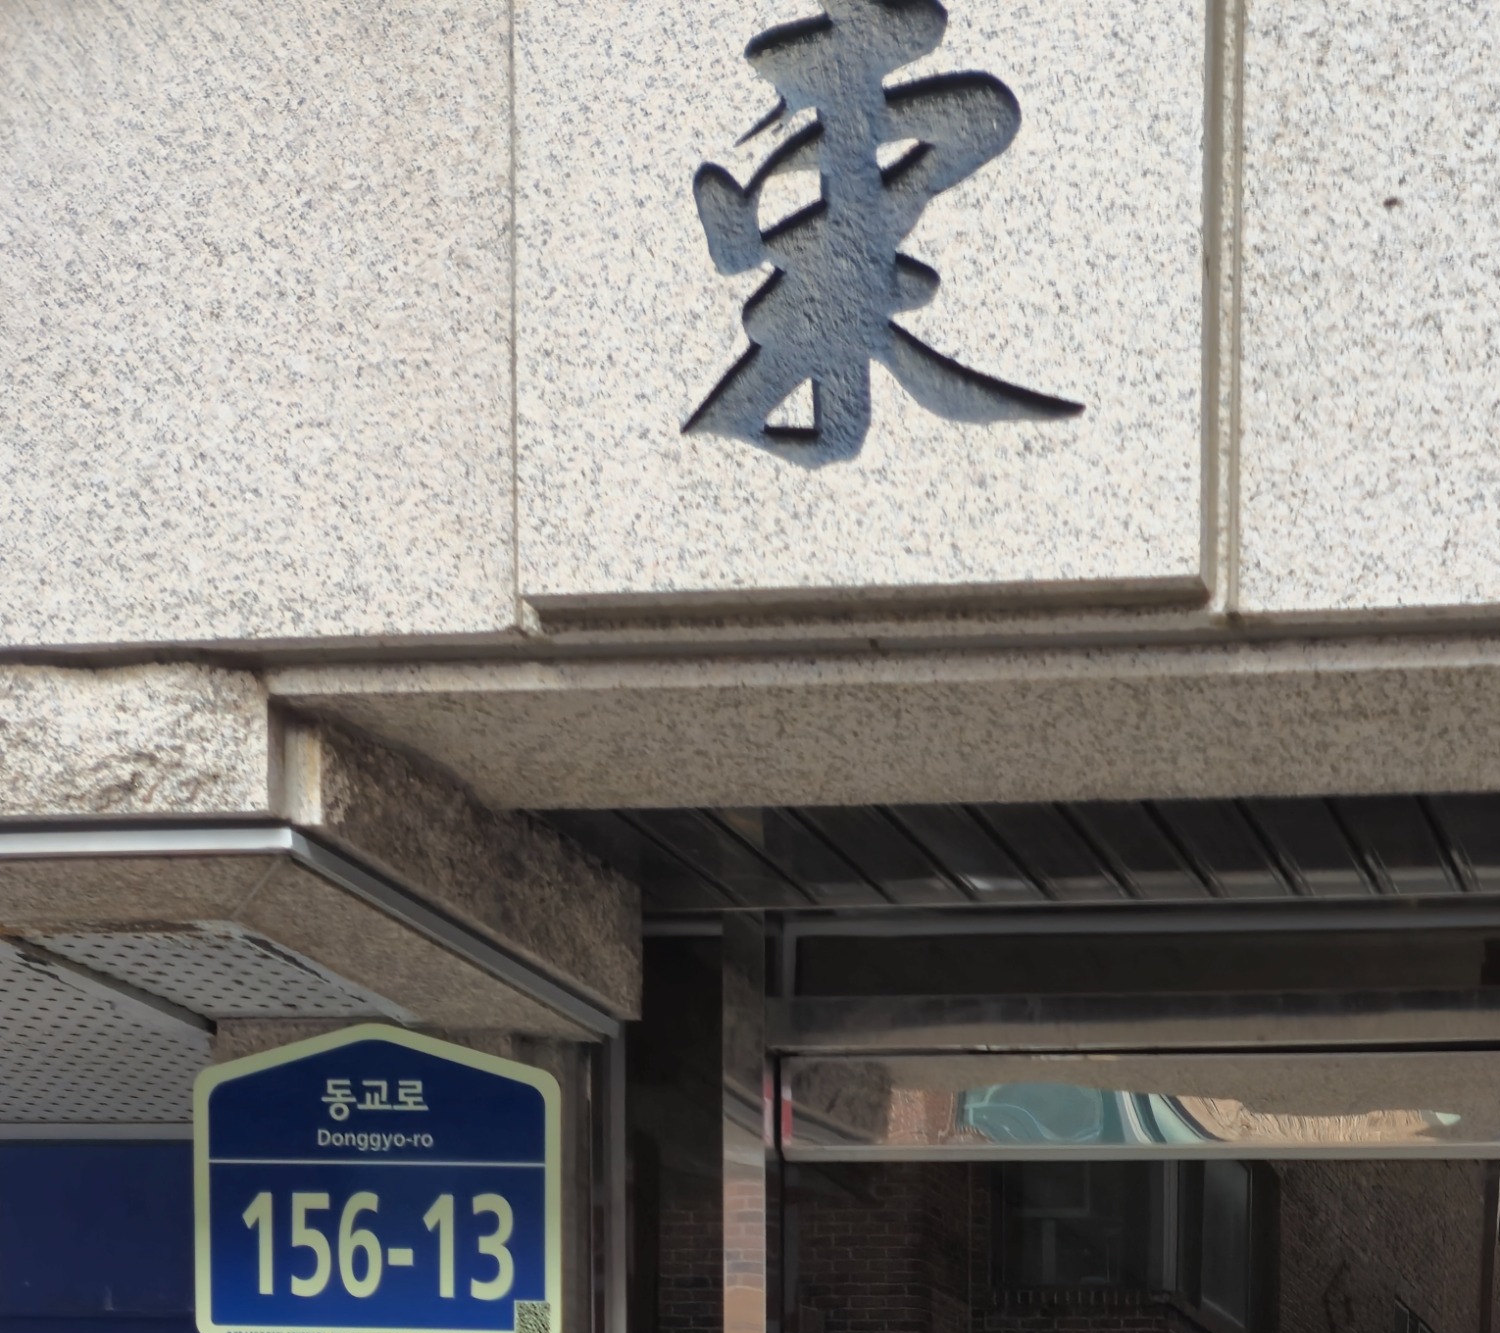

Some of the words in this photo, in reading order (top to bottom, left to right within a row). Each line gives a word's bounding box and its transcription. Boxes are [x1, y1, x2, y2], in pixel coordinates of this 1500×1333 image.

[320, 1079, 429, 1121] 동교로
[317, 1128, 434, 1152] Donggyo-ro
[241, 1189, 516, 1301] 156-13
